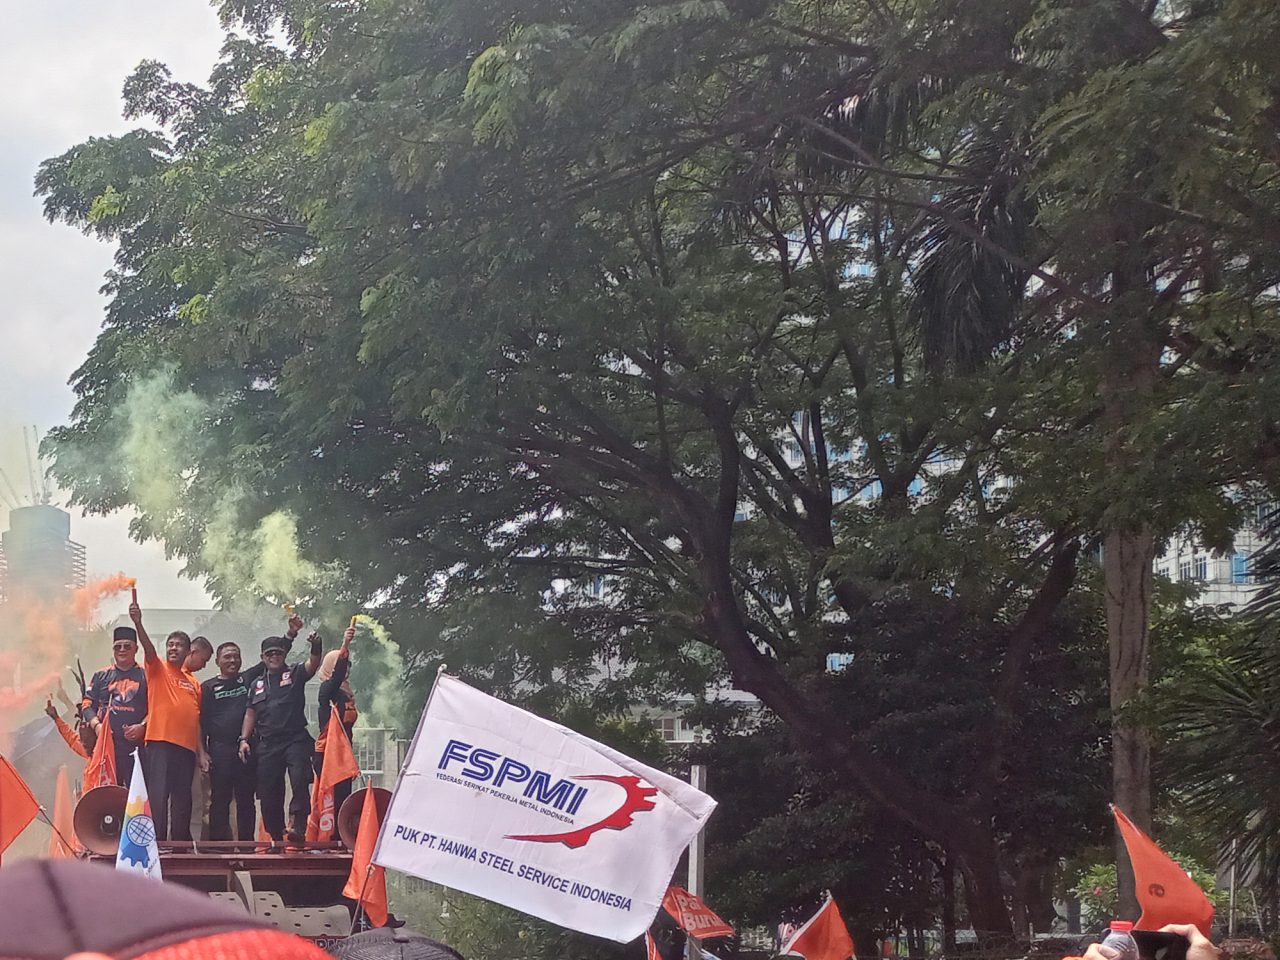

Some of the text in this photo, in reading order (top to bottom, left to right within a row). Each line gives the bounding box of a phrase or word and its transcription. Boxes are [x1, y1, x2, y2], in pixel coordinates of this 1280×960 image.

[436, 772, 574, 825] FEDERASI SERIKAT PEKERJA METAL INDONESIA
[438, 739, 588, 815] FSPMI
[394, 825, 632, 911] PUK PT. HANWA STEEL SERVICE INDONESIA
